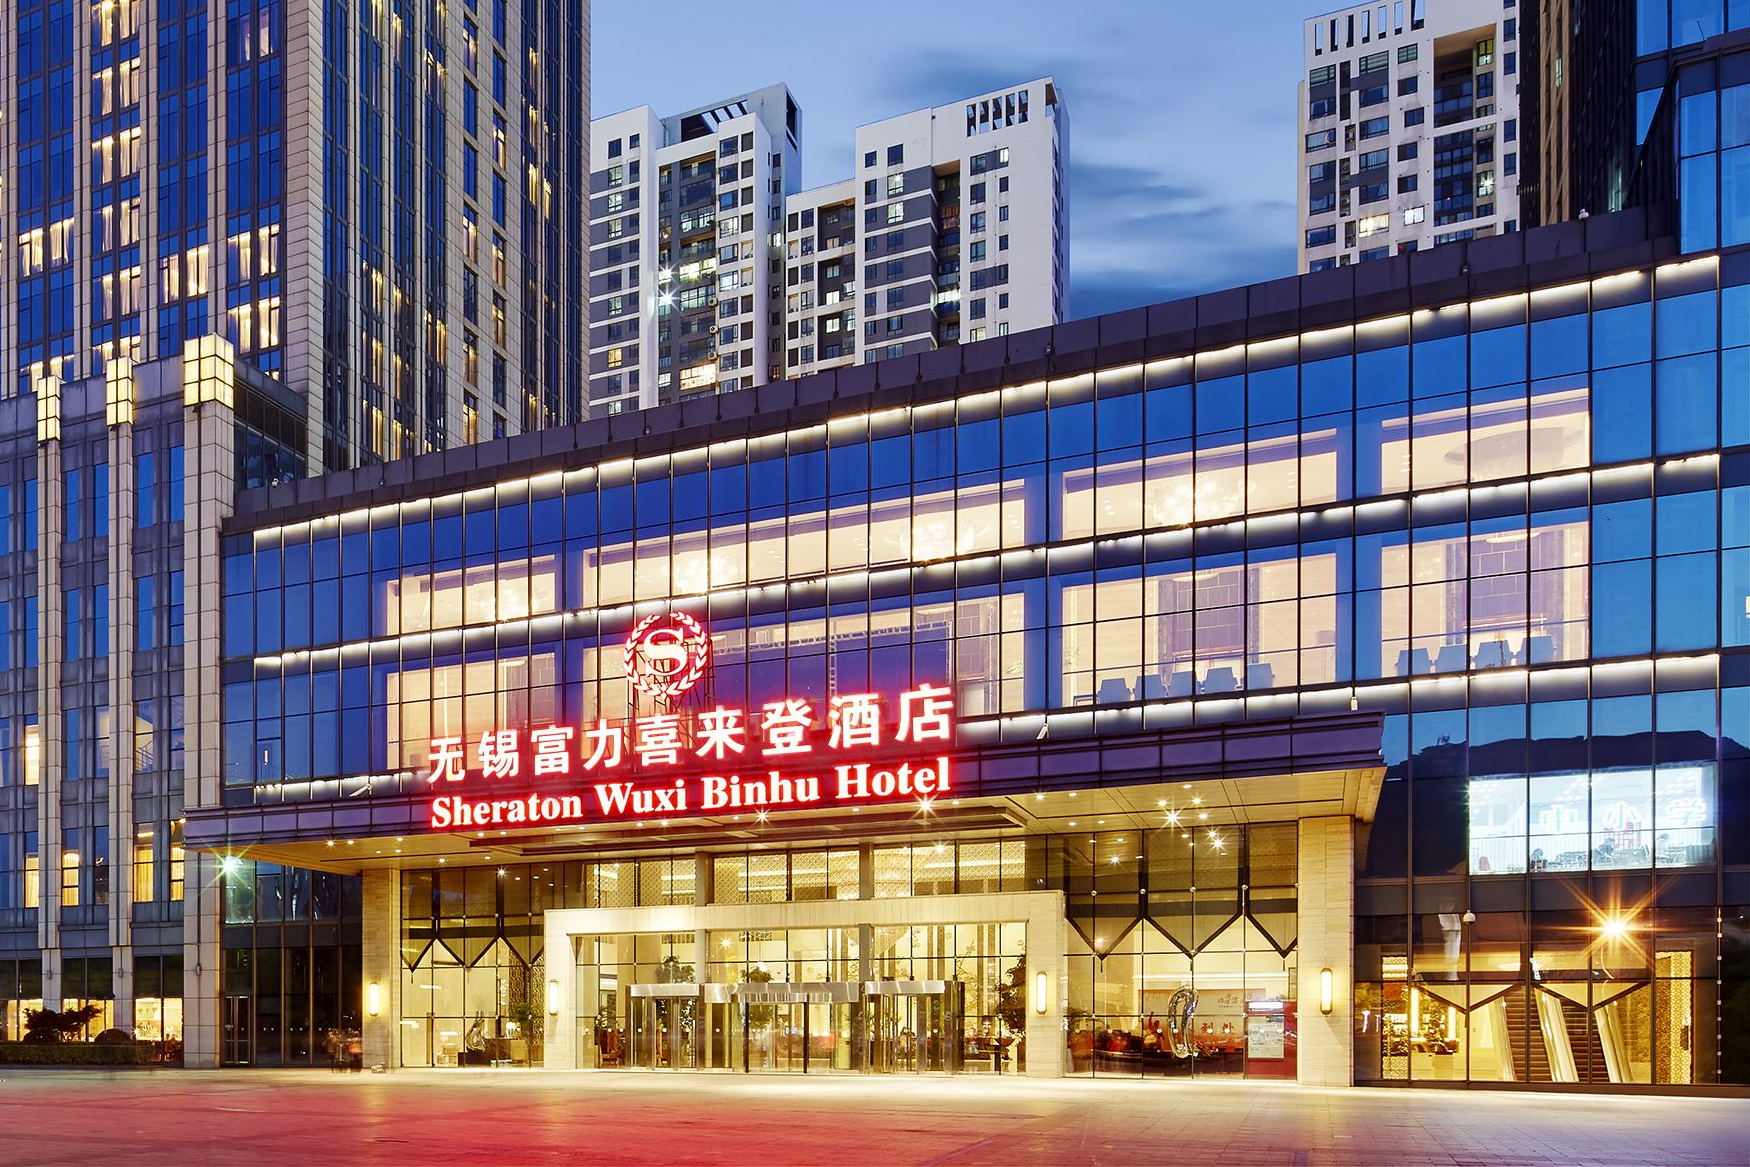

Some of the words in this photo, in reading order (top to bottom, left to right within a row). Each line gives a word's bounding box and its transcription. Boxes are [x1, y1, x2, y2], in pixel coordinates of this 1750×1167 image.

[426, 683, 954, 784] 无锡富力喜来登酒店
[431, 792, 583, 829] Sheraton
[594, 778, 688, 816] Wuxi
[700, 770, 821, 810] Binhu
[834, 756, 952, 800] Hotel
